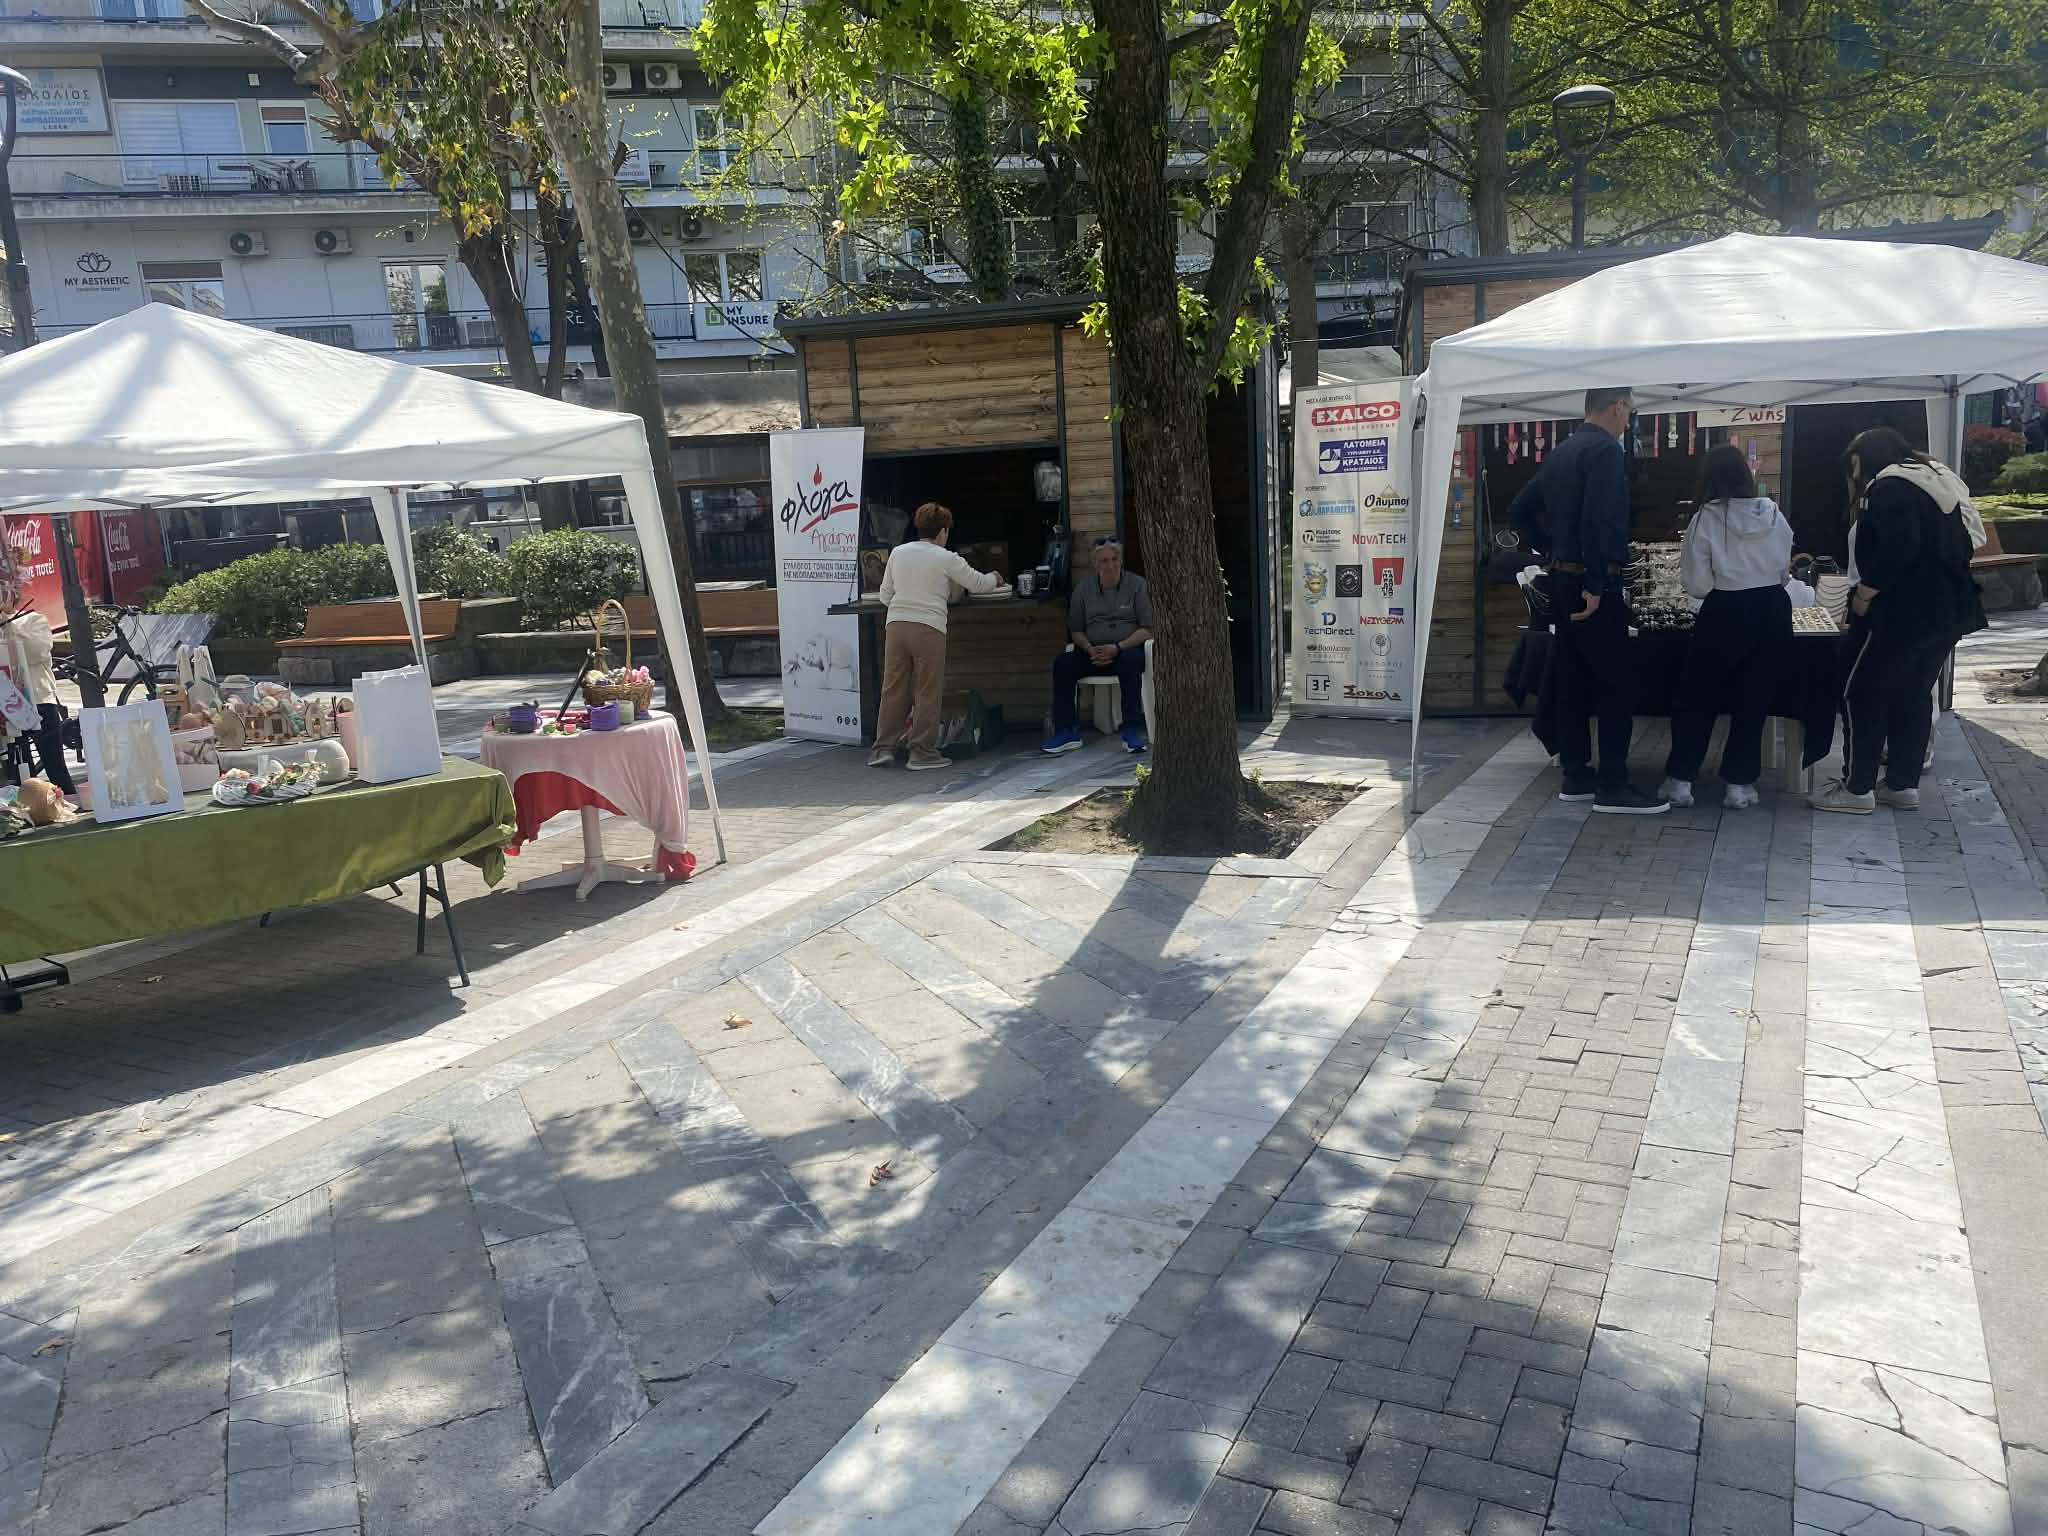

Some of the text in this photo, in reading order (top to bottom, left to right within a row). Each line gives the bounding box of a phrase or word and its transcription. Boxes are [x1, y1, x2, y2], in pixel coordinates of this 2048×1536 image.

[65, 277, 130, 287] MY AESTHETIC
[726, 305, 743, 315] MY
[727, 315, 769, 326] INSURE
[1316, 404, 1395, 424] EXALCO
[1343, 439, 1386, 449] ΛΑΤΟΜΕΙΑ
[1342, 457, 1385, 466] ΚΡΑΤΑΙΟΣ
[1304, 627, 1355, 636] TechDirect
